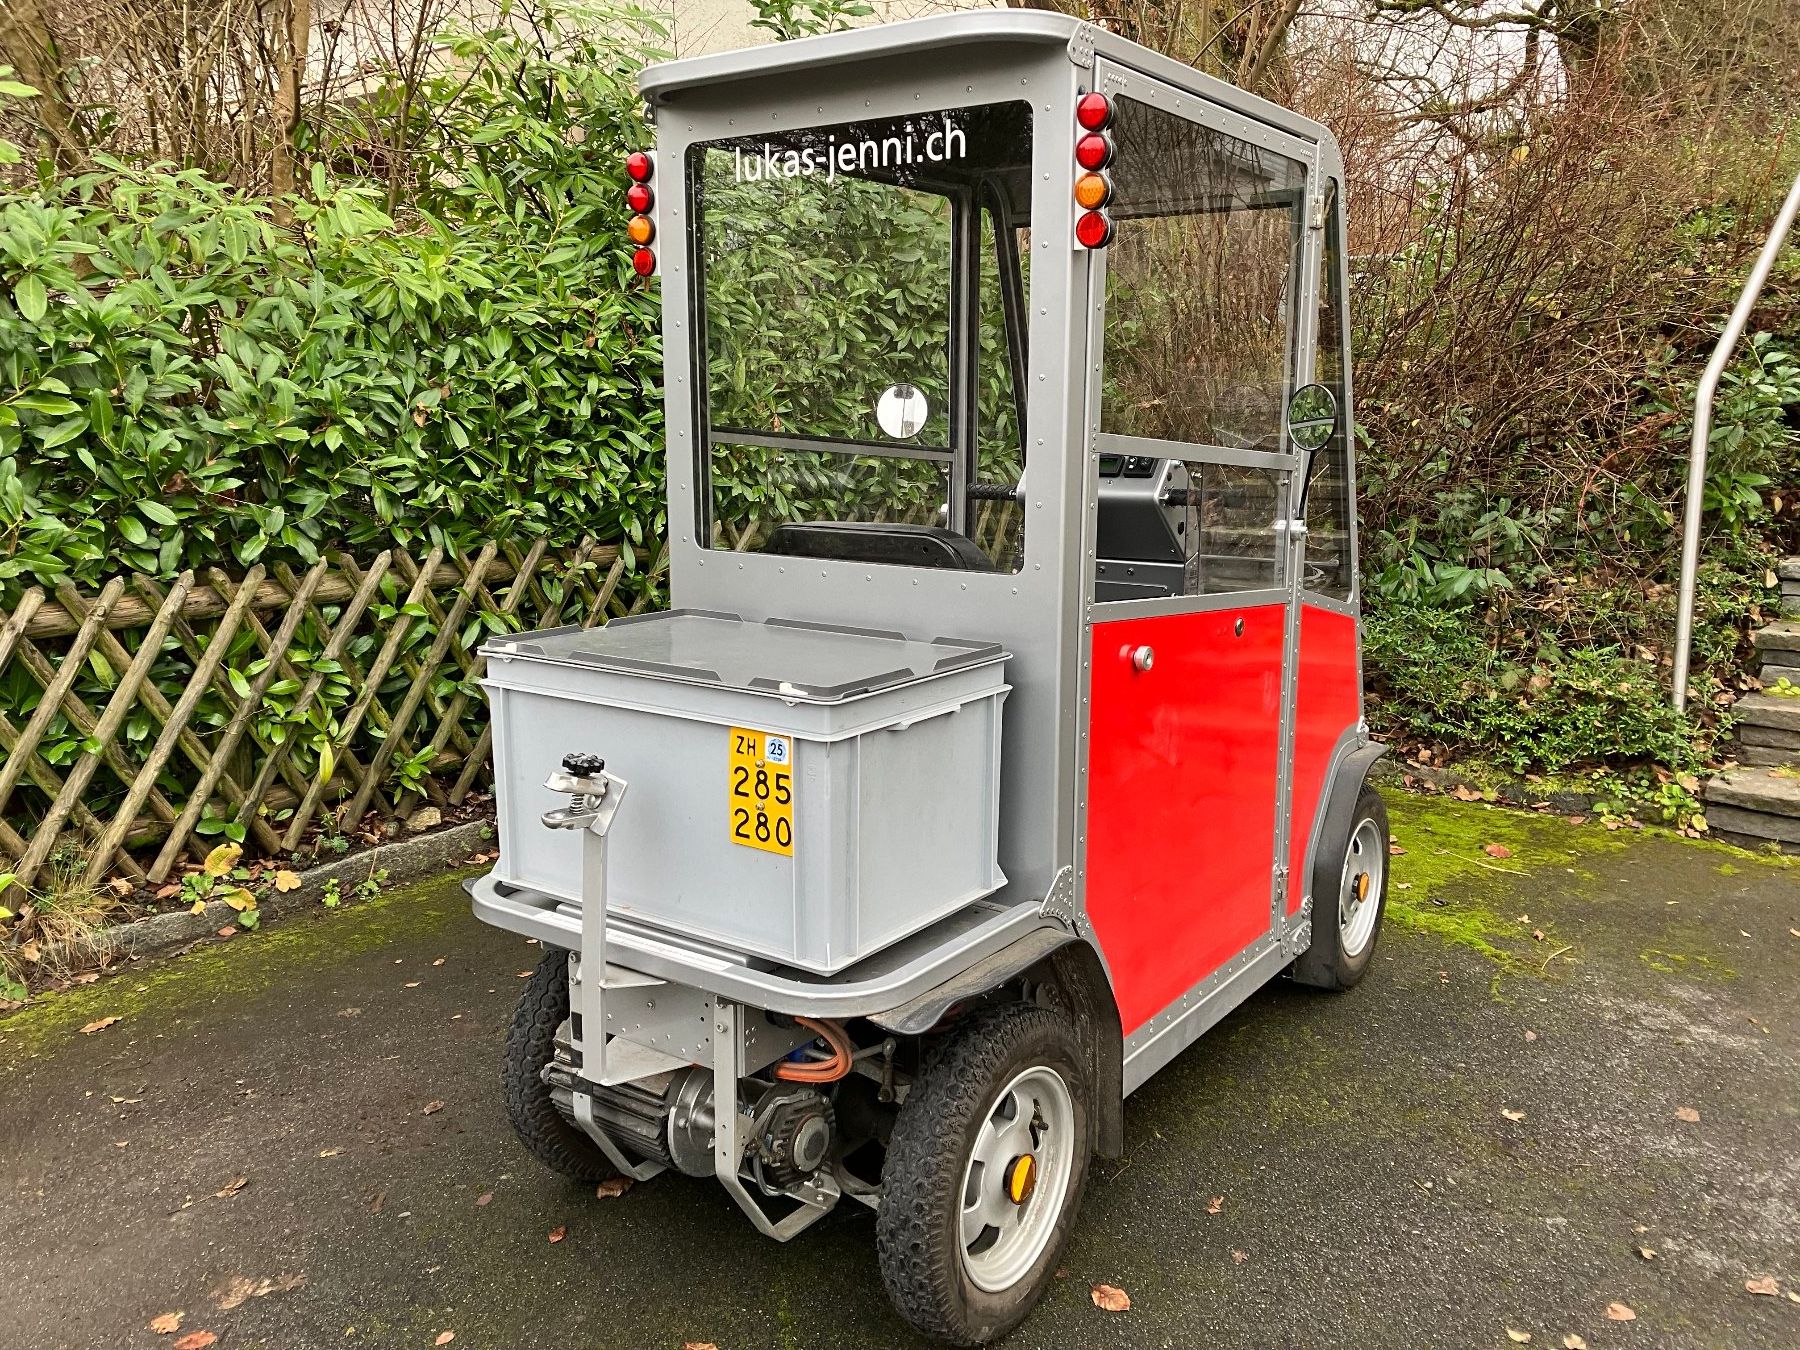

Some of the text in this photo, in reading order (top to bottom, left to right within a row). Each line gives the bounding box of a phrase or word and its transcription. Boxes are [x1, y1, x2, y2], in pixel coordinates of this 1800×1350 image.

[735, 119, 966, 184] lukas-jenni.ch
[736, 735, 756, 756] ZH
[770, 742, 783, 756] 25
[734, 766, 791, 805] 285
[734, 808, 792, 847] 280
